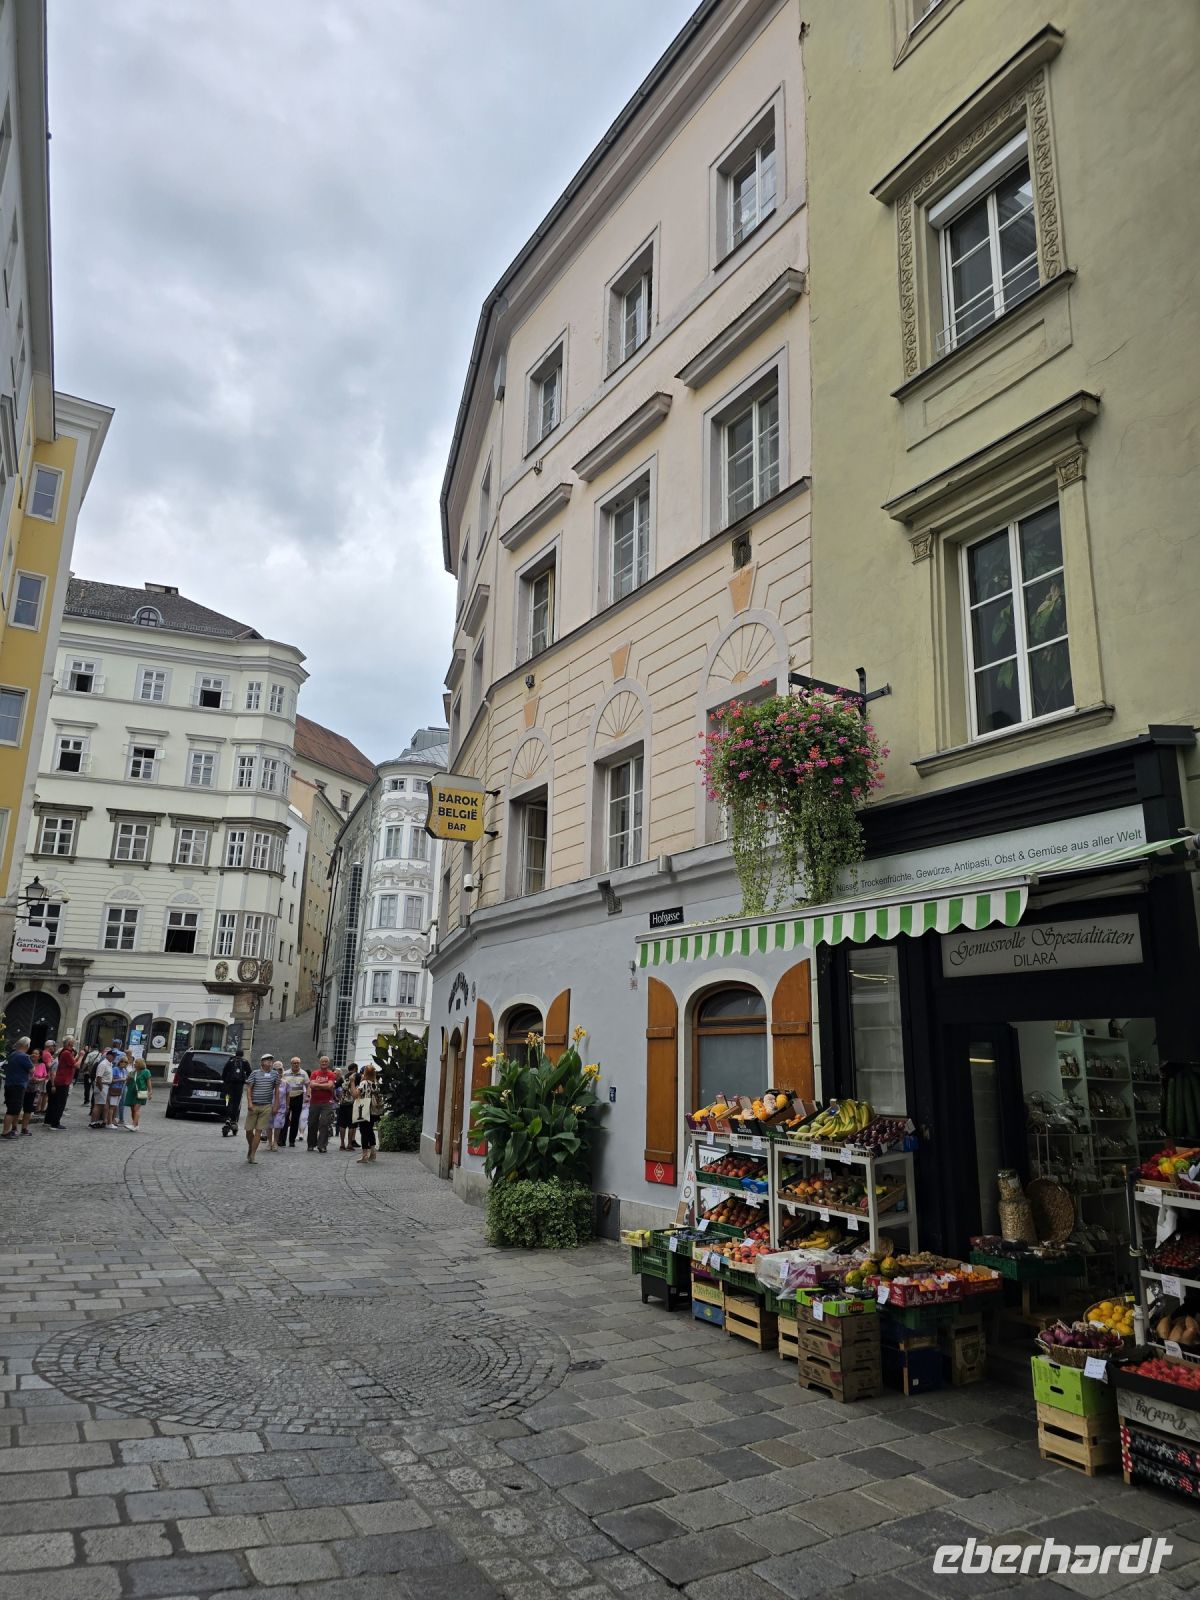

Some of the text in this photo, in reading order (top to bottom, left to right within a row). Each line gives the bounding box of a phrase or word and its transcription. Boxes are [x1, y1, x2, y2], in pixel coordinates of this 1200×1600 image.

[439, 793, 478, 806] BAROK
[438, 807, 477, 820] BELGIË
[448, 822, 466, 831] BAR
[860, 873, 914, 887] Trockenfrüchte,
[915, 863, 953, 878] Gewürze,
[954, 857, 993, 872] Antipasti,
[994, 851, 1017, 865] Obst
[1018, 849, 1026, 861] &
[1027, 843, 1067, 857] Gemüse
[1070, 840, 1089, 852] aus
[1092, 833, 1115, 847] aller
[1116, 828, 1142, 844] Welt
[652, 911, 680, 925] Hofgasse
[949, 925, 1135, 965] Genussvolle Spezialitäten
[1013, 951, 1058, 968] DILARA
